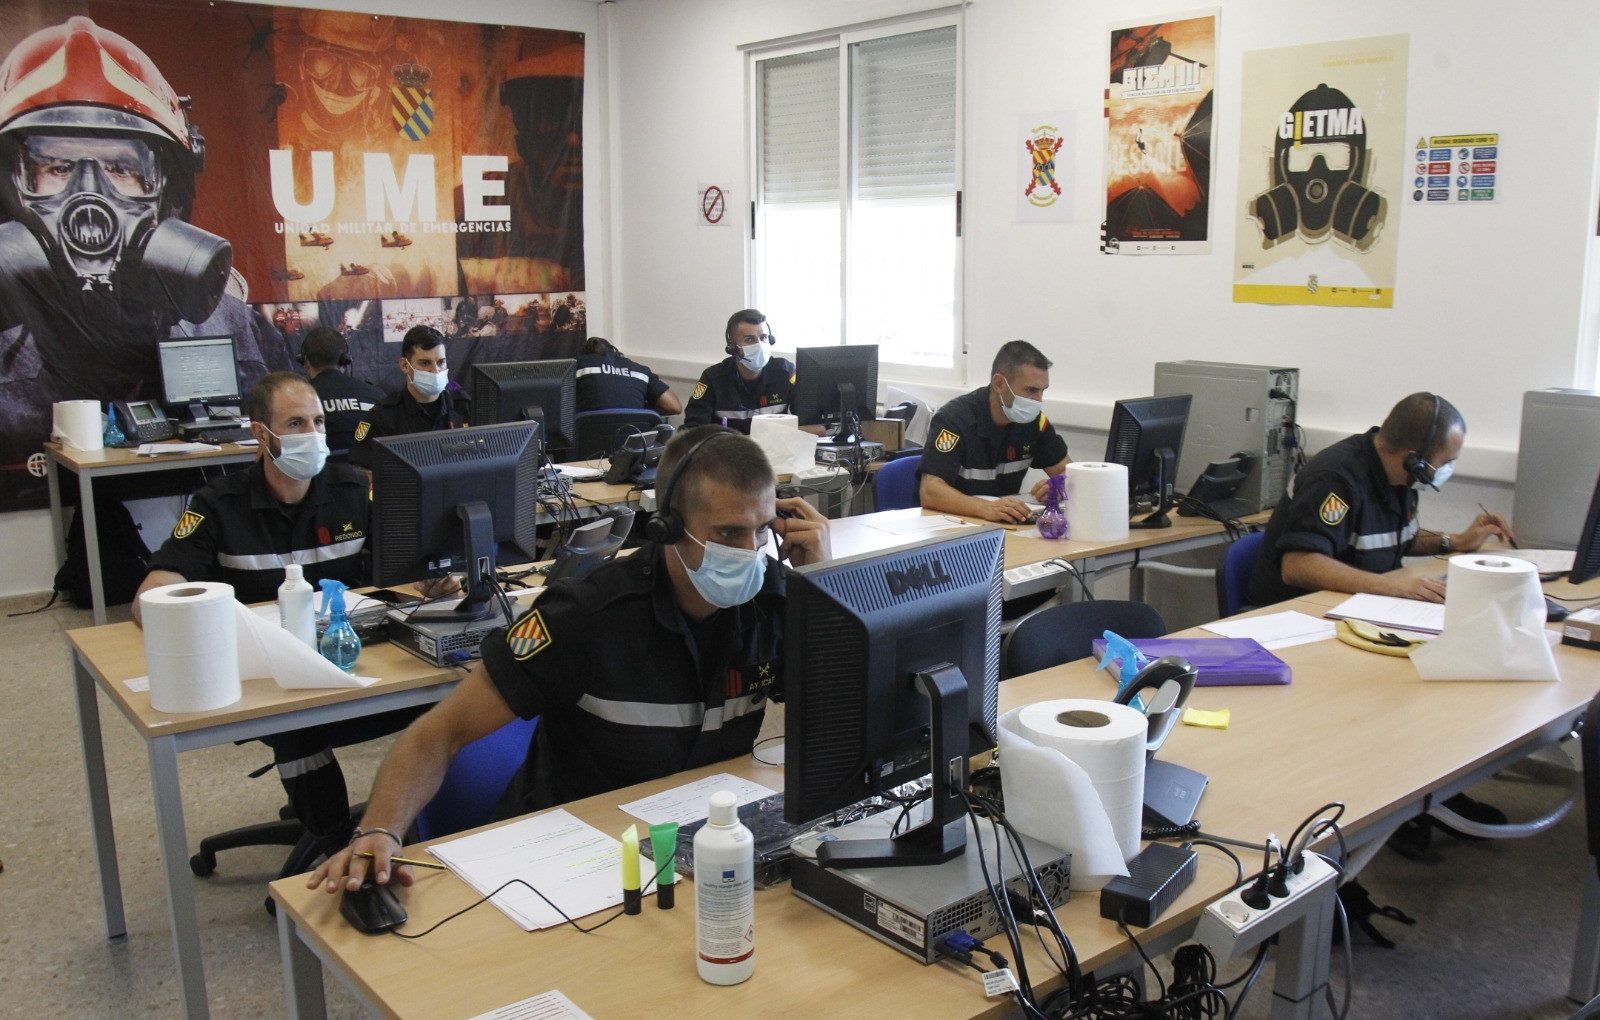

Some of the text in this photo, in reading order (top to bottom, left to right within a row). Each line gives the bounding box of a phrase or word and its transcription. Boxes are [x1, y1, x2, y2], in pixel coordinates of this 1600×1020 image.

[1279, 107, 1364, 141] GIETMA
[269, 149, 511, 223] UME
[274, 221, 512, 234] UNIDAD MILITAR DE EMERGENCIAS
[601, 363, 630, 377] UME
[323, 398, 360, 412] UME
[334, 530, 363, 542] REDONDO
